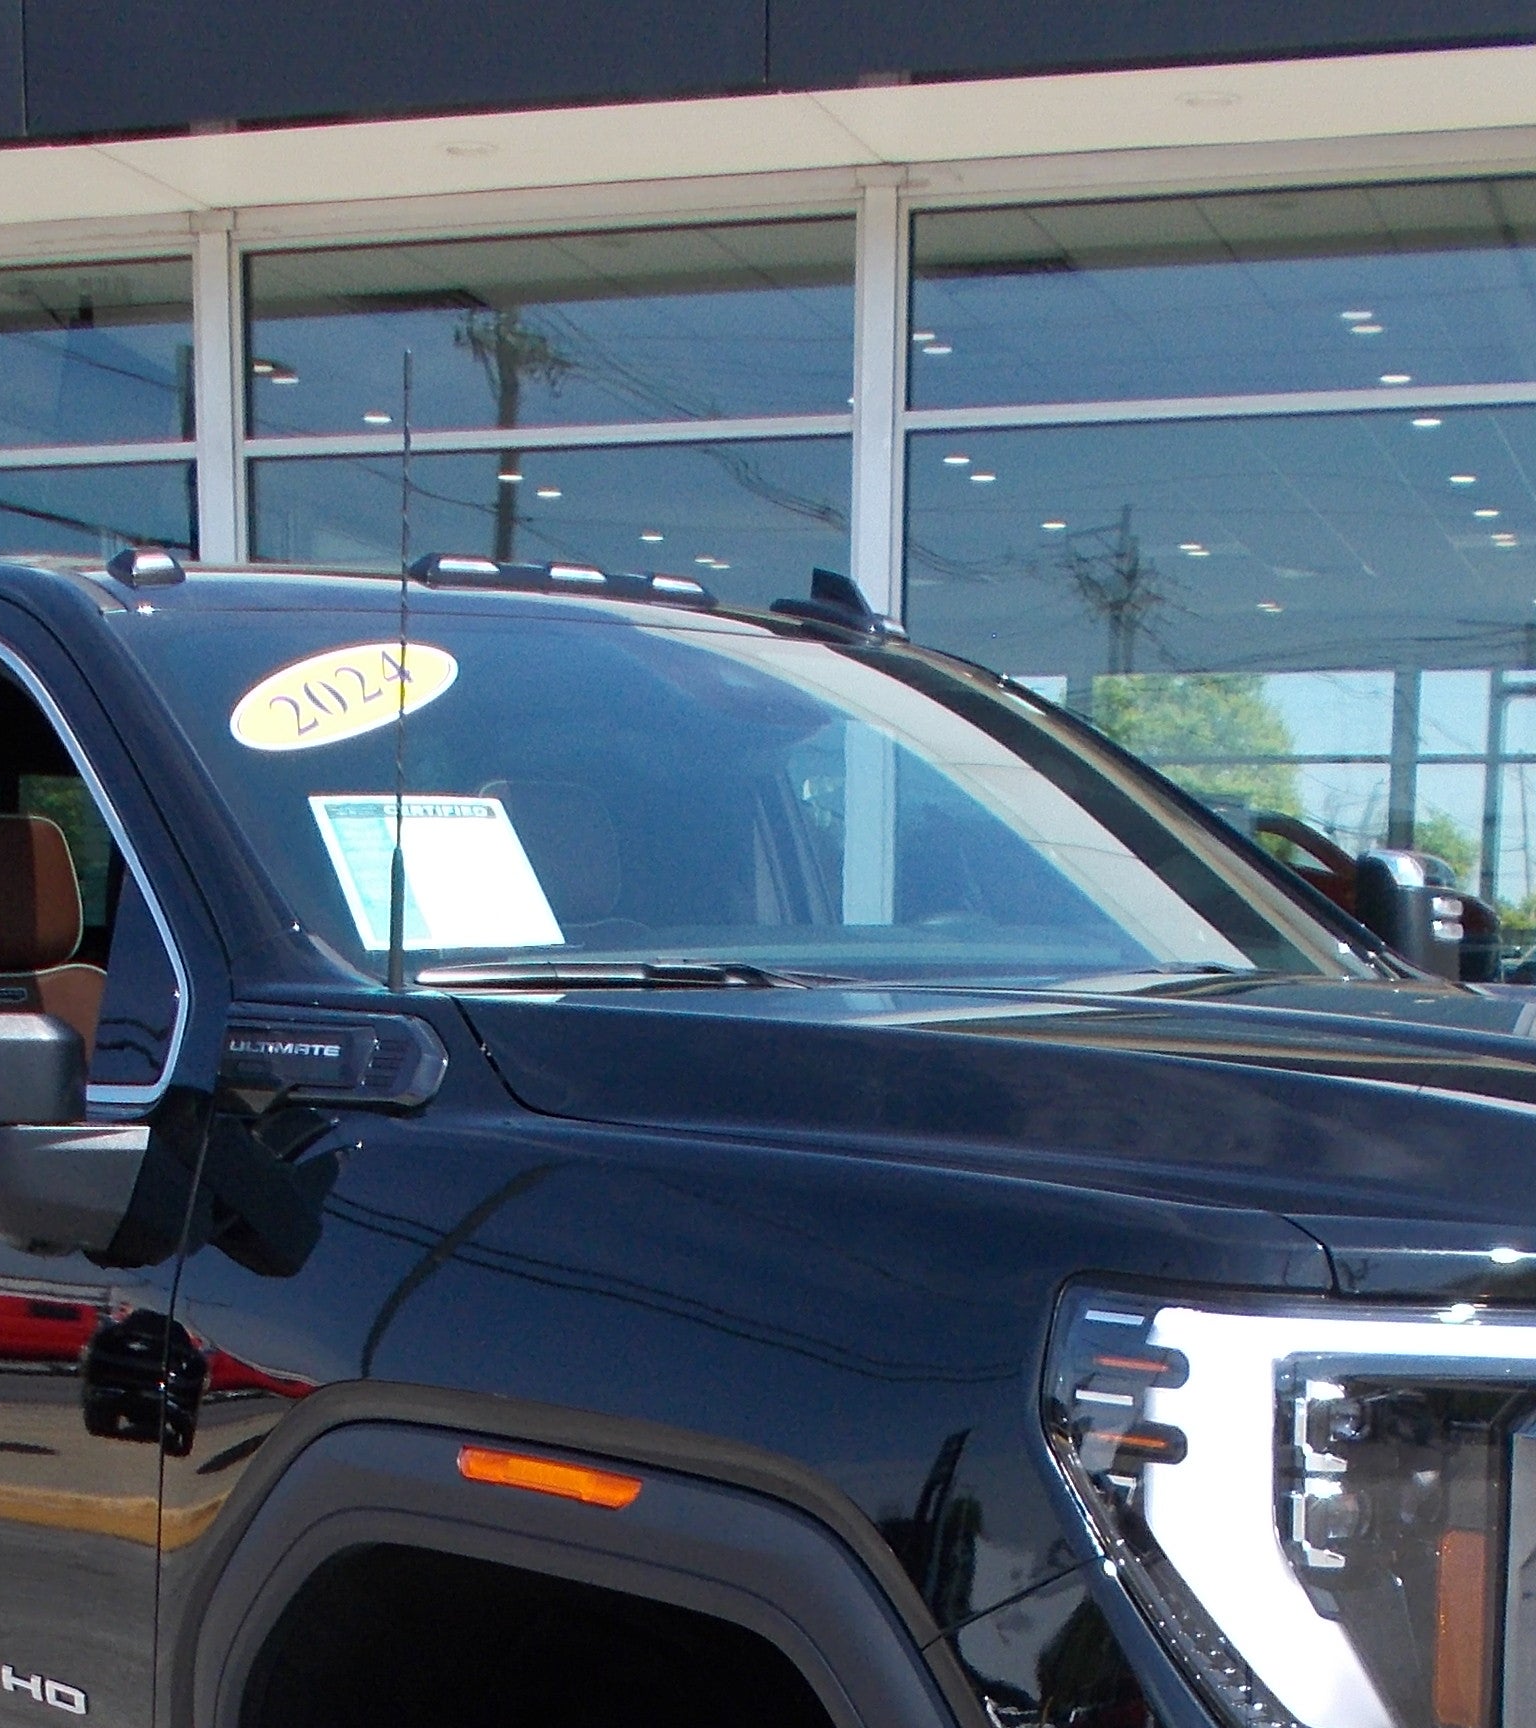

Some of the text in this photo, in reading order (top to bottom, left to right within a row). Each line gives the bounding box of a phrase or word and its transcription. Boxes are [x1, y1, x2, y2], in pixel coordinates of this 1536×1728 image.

[269, 650, 414, 736] 2024
[229, 1039, 342, 1058] ULTIMATE
[1, 1663, 88, 1715] HD
